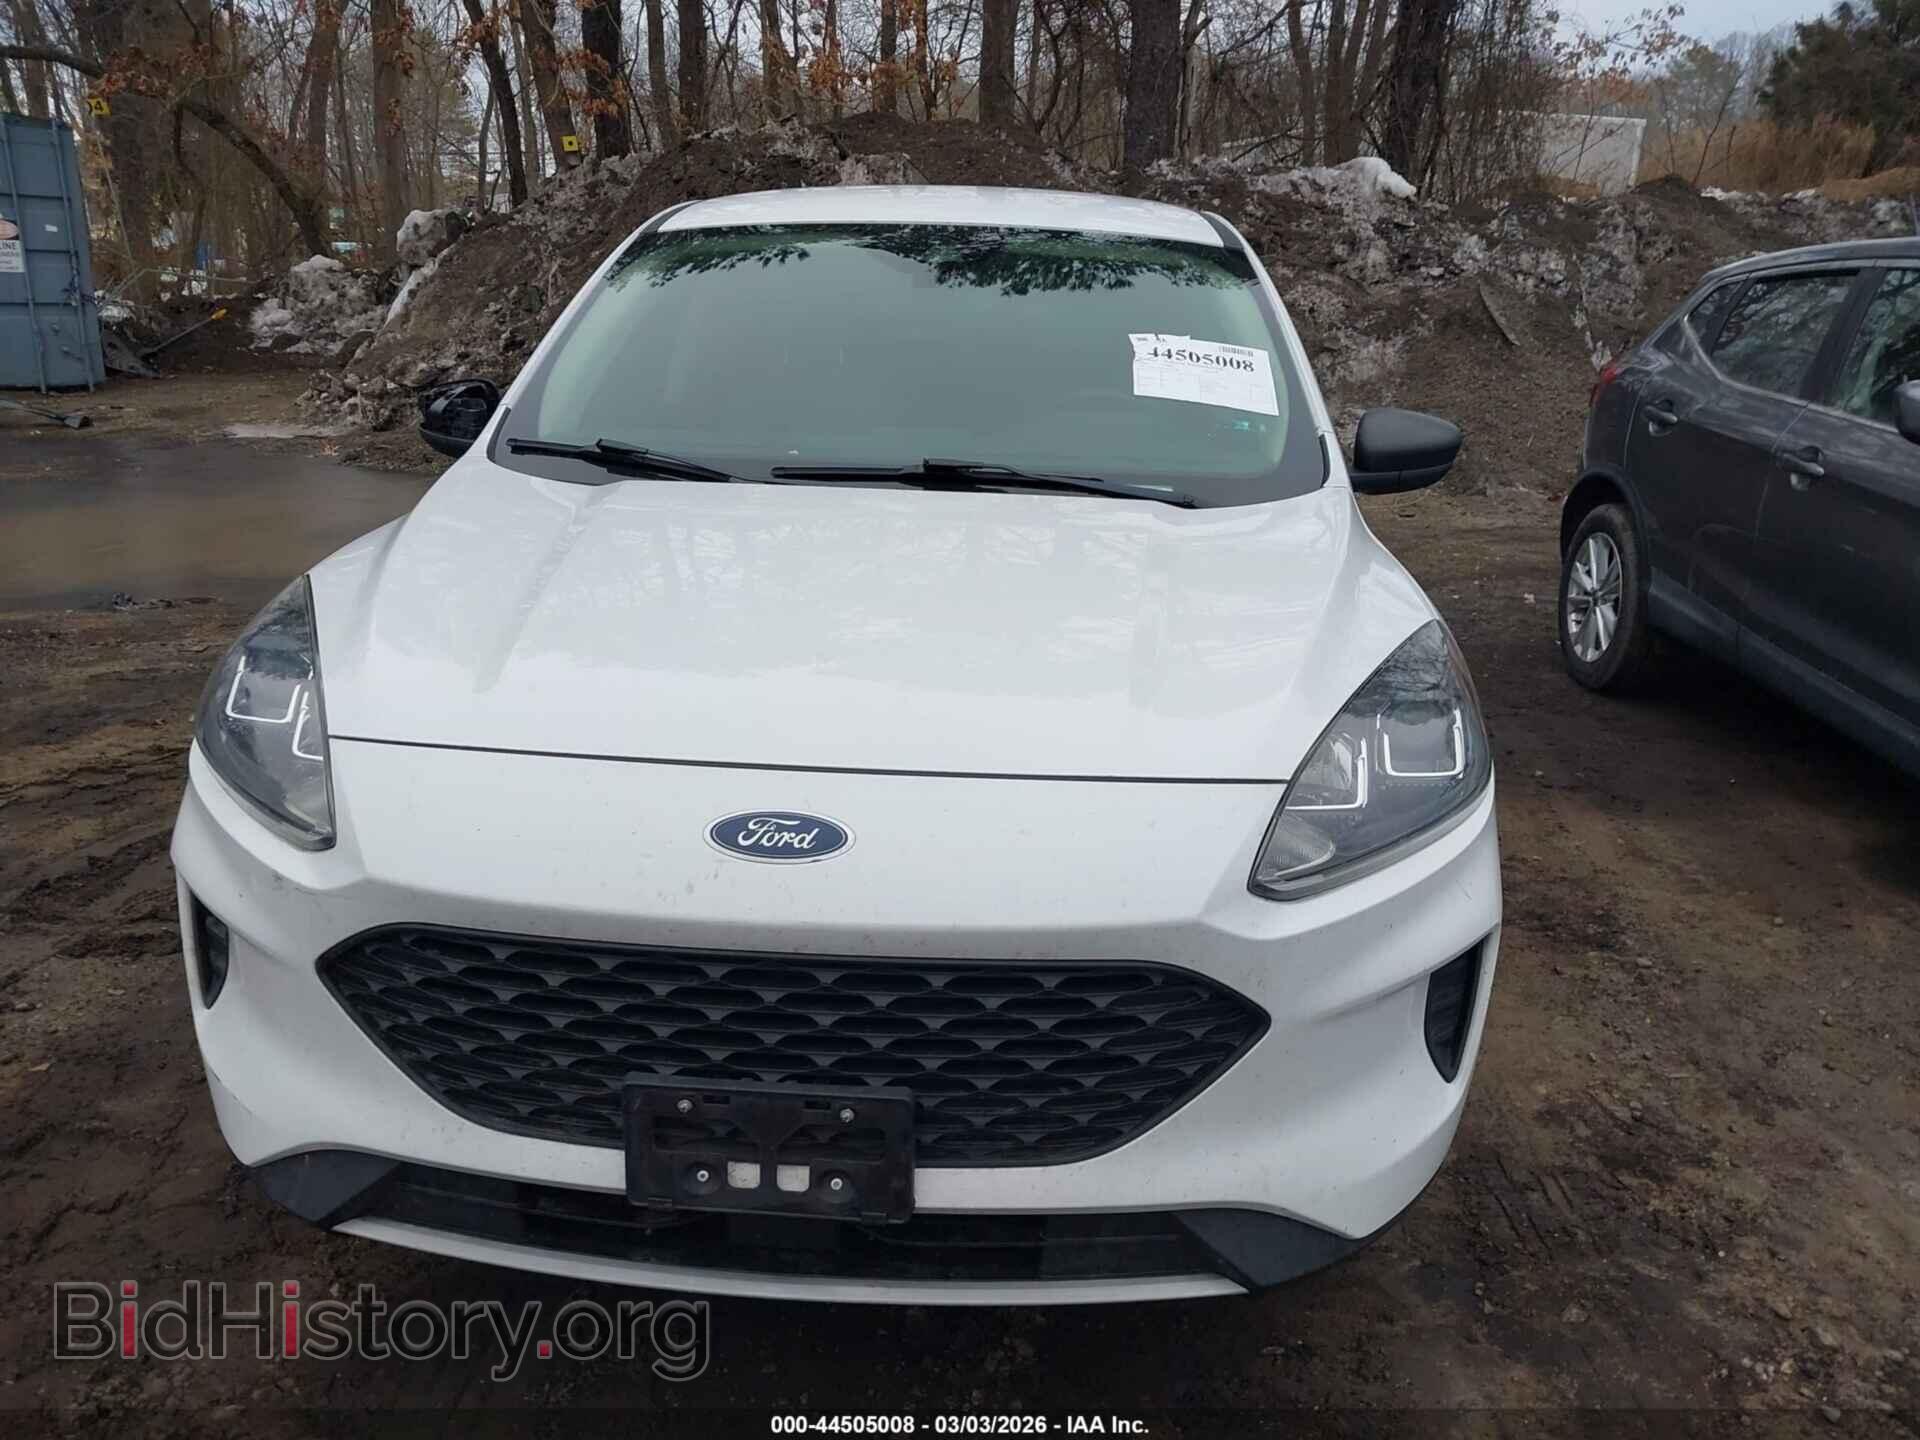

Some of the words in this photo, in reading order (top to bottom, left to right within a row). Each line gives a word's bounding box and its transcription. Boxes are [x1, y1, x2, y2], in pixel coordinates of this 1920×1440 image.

[0, 240, 16, 250] INE
[1147, 346, 1255, 372] 44505008
[737, 817, 820, 849] Ford
